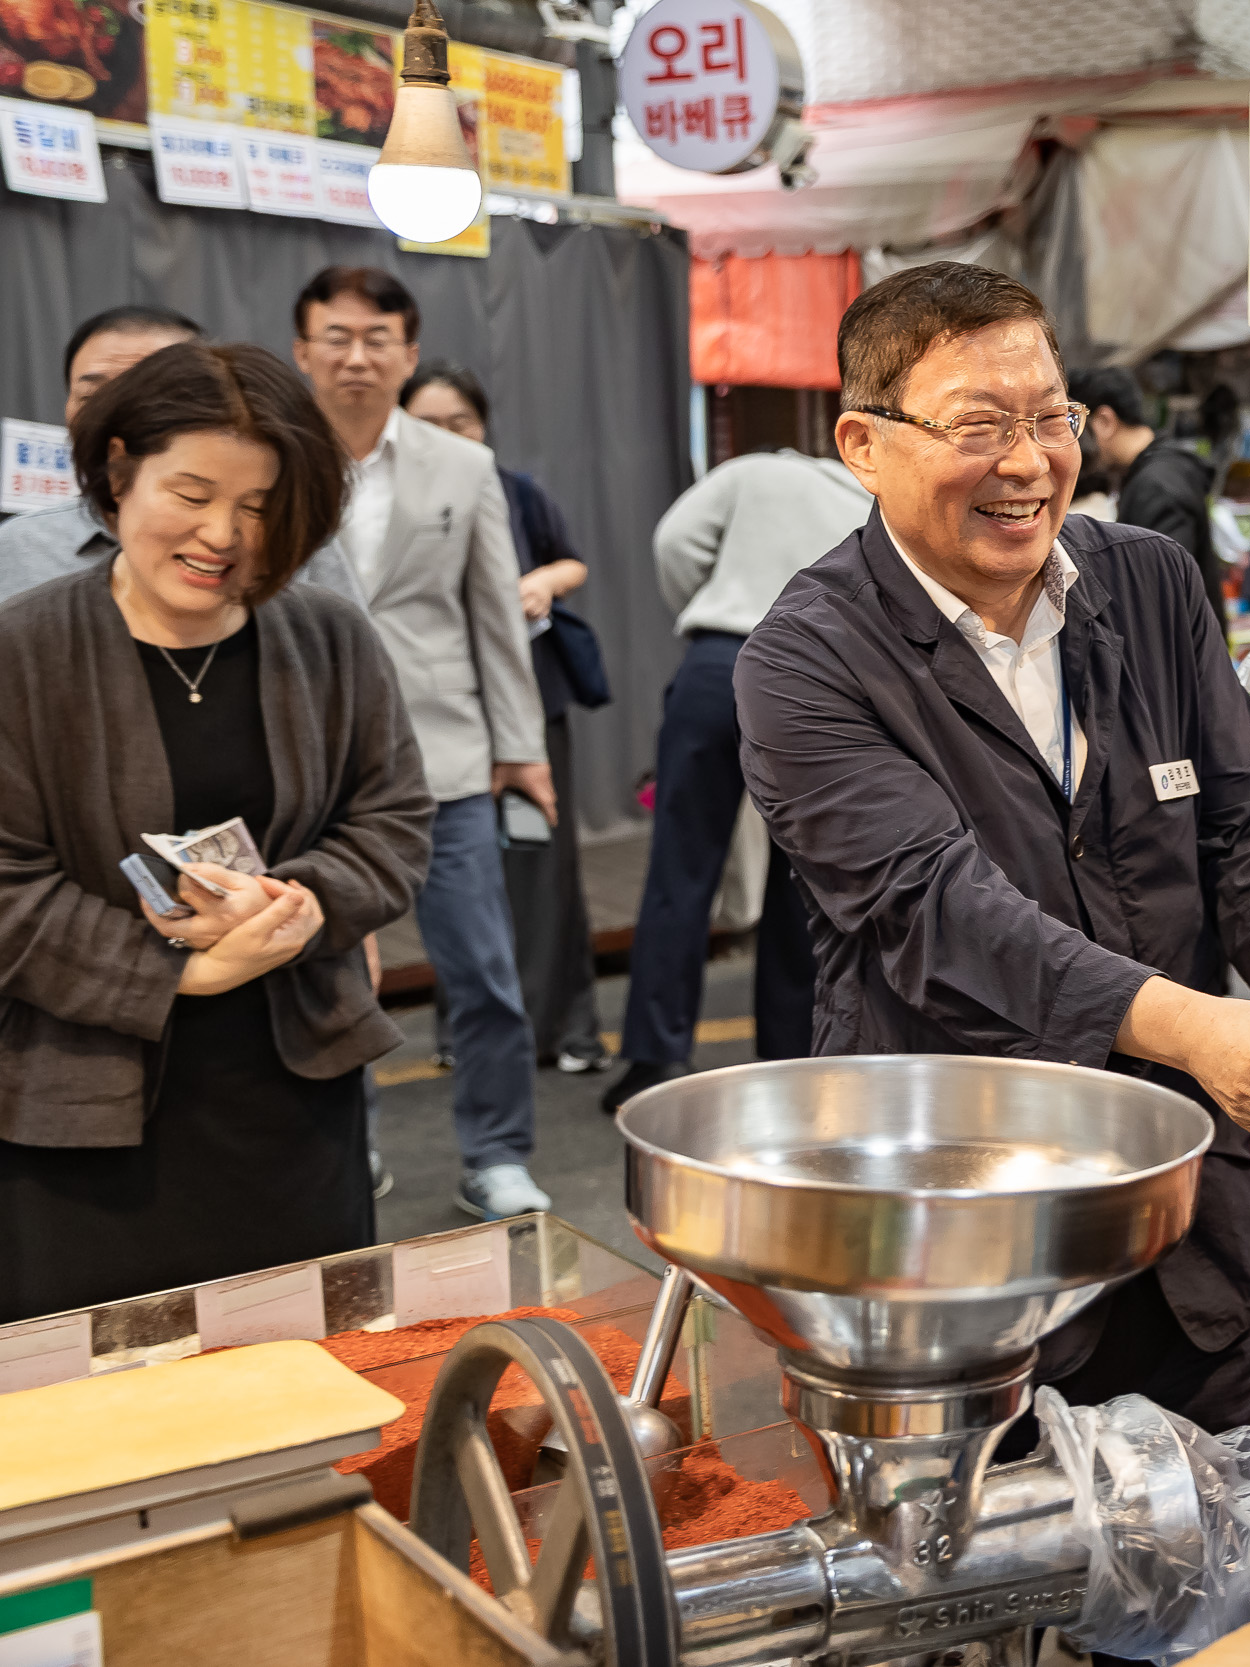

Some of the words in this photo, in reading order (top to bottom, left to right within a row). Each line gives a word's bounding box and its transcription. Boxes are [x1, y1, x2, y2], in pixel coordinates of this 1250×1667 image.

[644, 15, 748, 86] 오리
[644, 94, 754, 146] 바베큐
[933, 1600, 996, 1629] Shin
